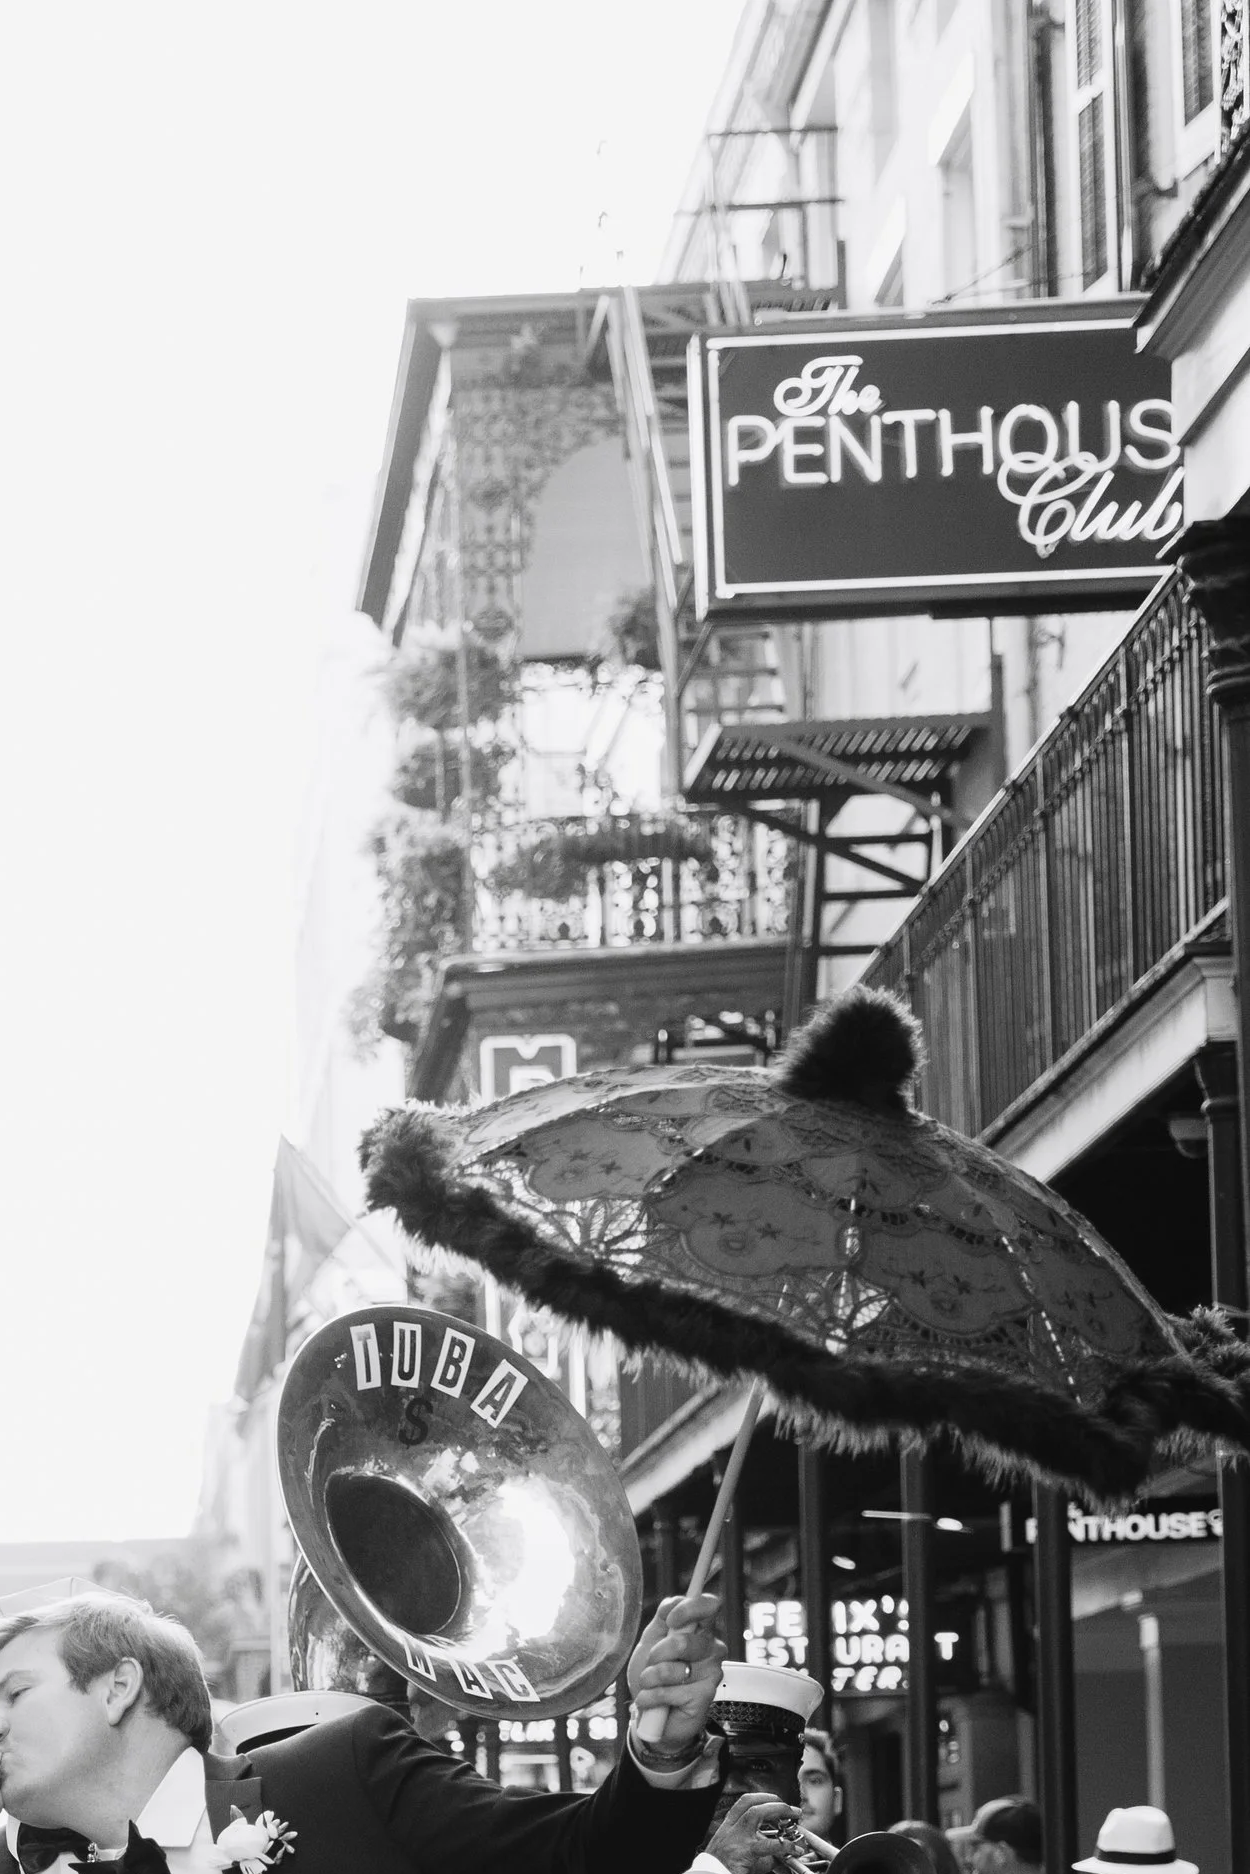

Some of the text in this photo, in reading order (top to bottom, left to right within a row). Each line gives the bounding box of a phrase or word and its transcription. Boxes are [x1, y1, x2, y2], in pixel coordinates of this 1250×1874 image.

[773, 354, 883, 418] The
[727, 399, 1182, 487] PENTHOUS
[997, 451, 1186, 554] Club
[352, 1324, 524, 1425] TUBA
[1025, 1511, 1208, 1543] NTHOUSE
